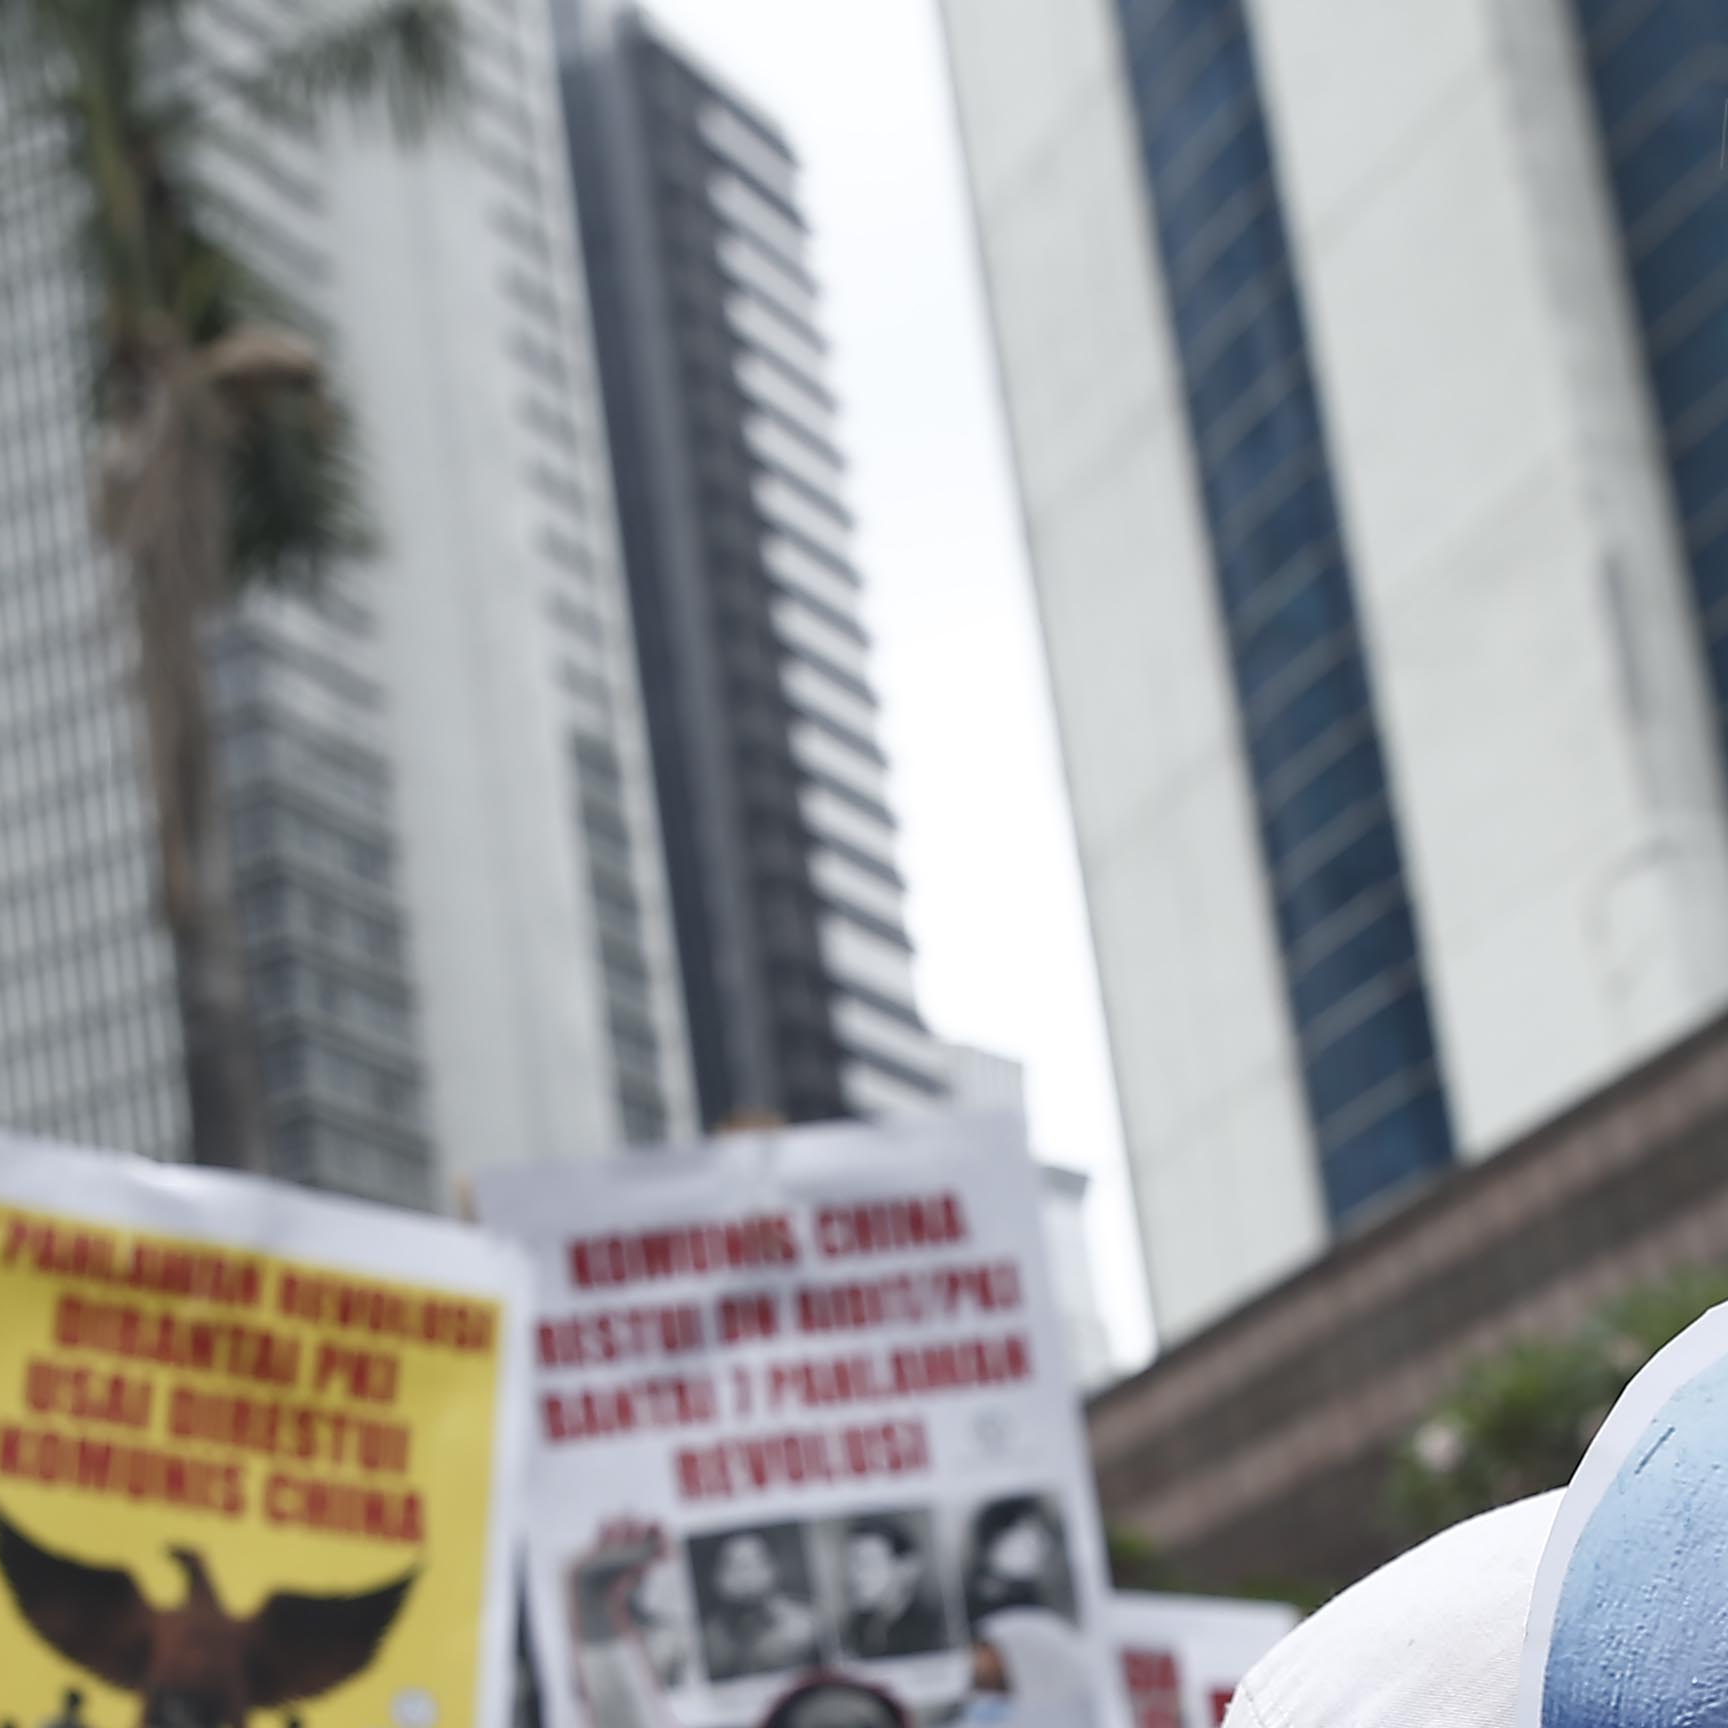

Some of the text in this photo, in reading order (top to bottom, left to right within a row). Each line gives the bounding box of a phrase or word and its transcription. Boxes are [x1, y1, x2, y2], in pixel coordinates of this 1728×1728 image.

[564, 1188, 971, 1295] KOMUNIS CHINA
[50, 1287, 403, 1412] DIBANTAI PKI
[274, 1264, 498, 1359] REVOLUSI
[531, 1297, 707, 1375] RESTUI
[713, 1286, 783, 1351] DN
[20, 1353, 416, 1482] USAI DIRESTUI
[536, 1369, 720, 1449] BANTAI
[759, 1328, 1035, 1419] PAHLAWAN
[259, 1464, 427, 1551] CHINA
[669, 1411, 933, 1508] REVOLUSI
